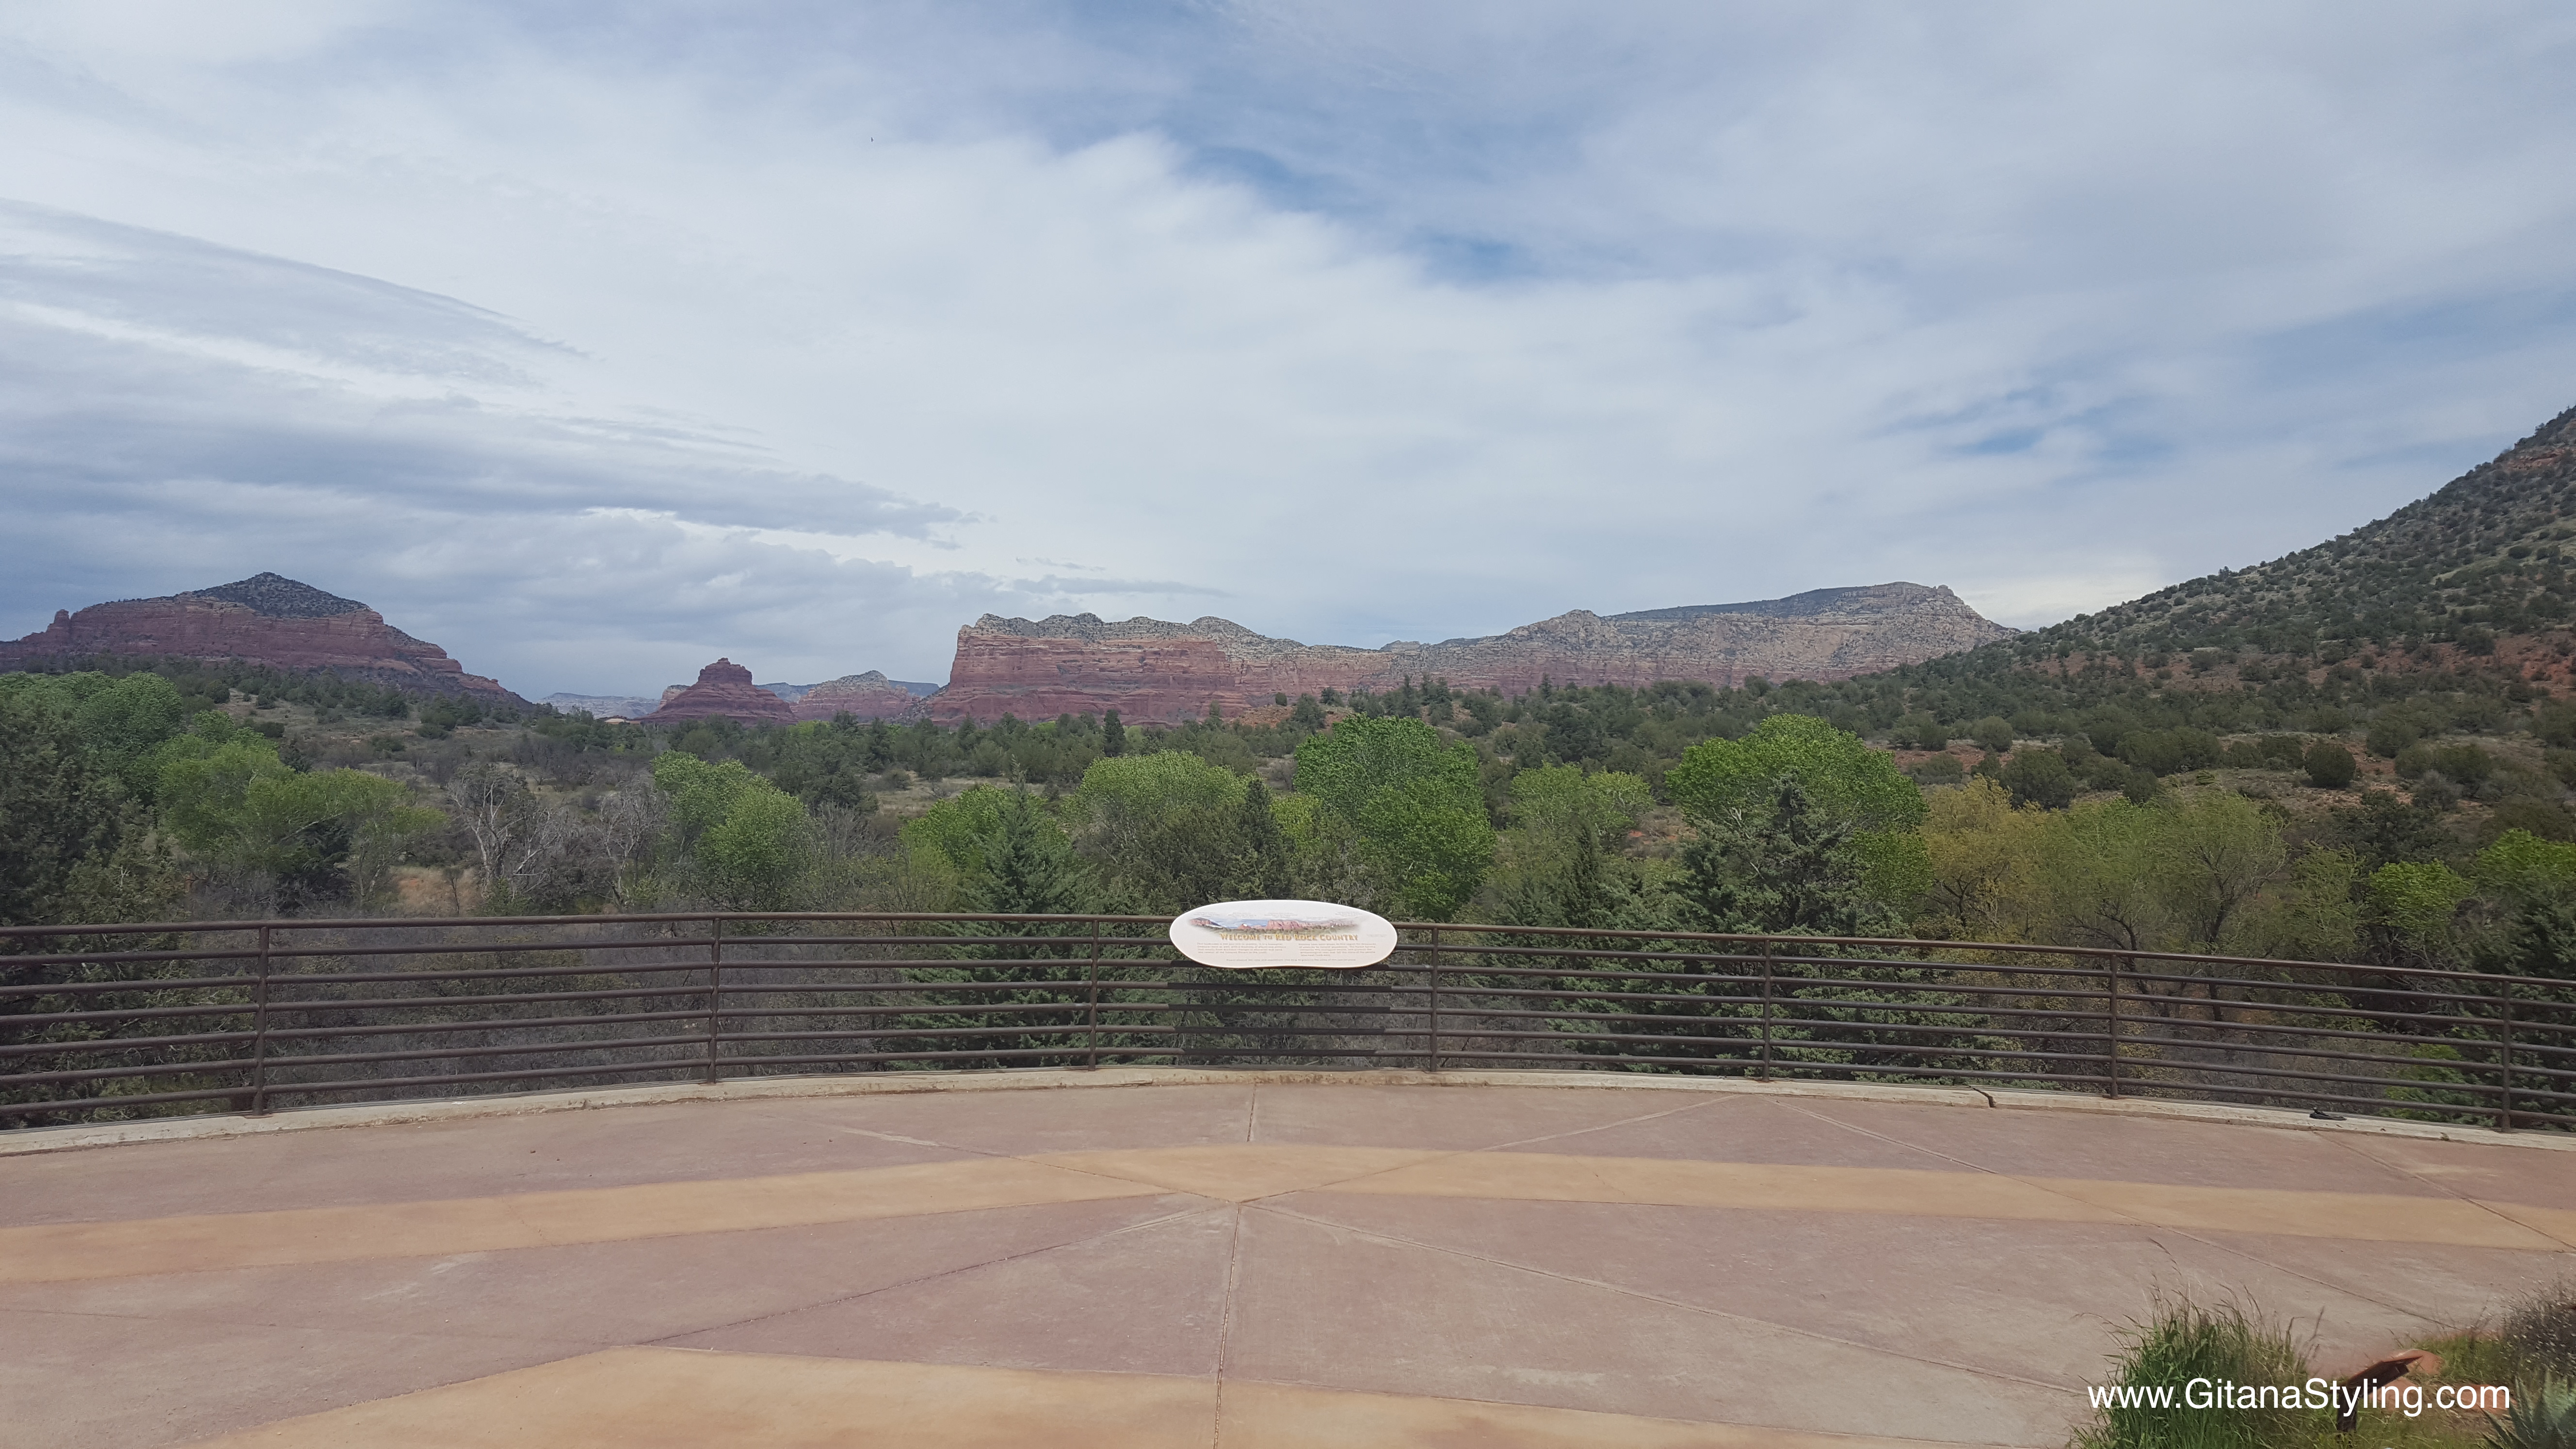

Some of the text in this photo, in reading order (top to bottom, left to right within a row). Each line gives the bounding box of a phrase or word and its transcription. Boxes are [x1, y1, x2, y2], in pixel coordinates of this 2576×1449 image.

[1275, 932, 1292, 941] RED
[1293, 932, 1317, 941] ROCK
[1319, 933, 1358, 941] COUNTRY
